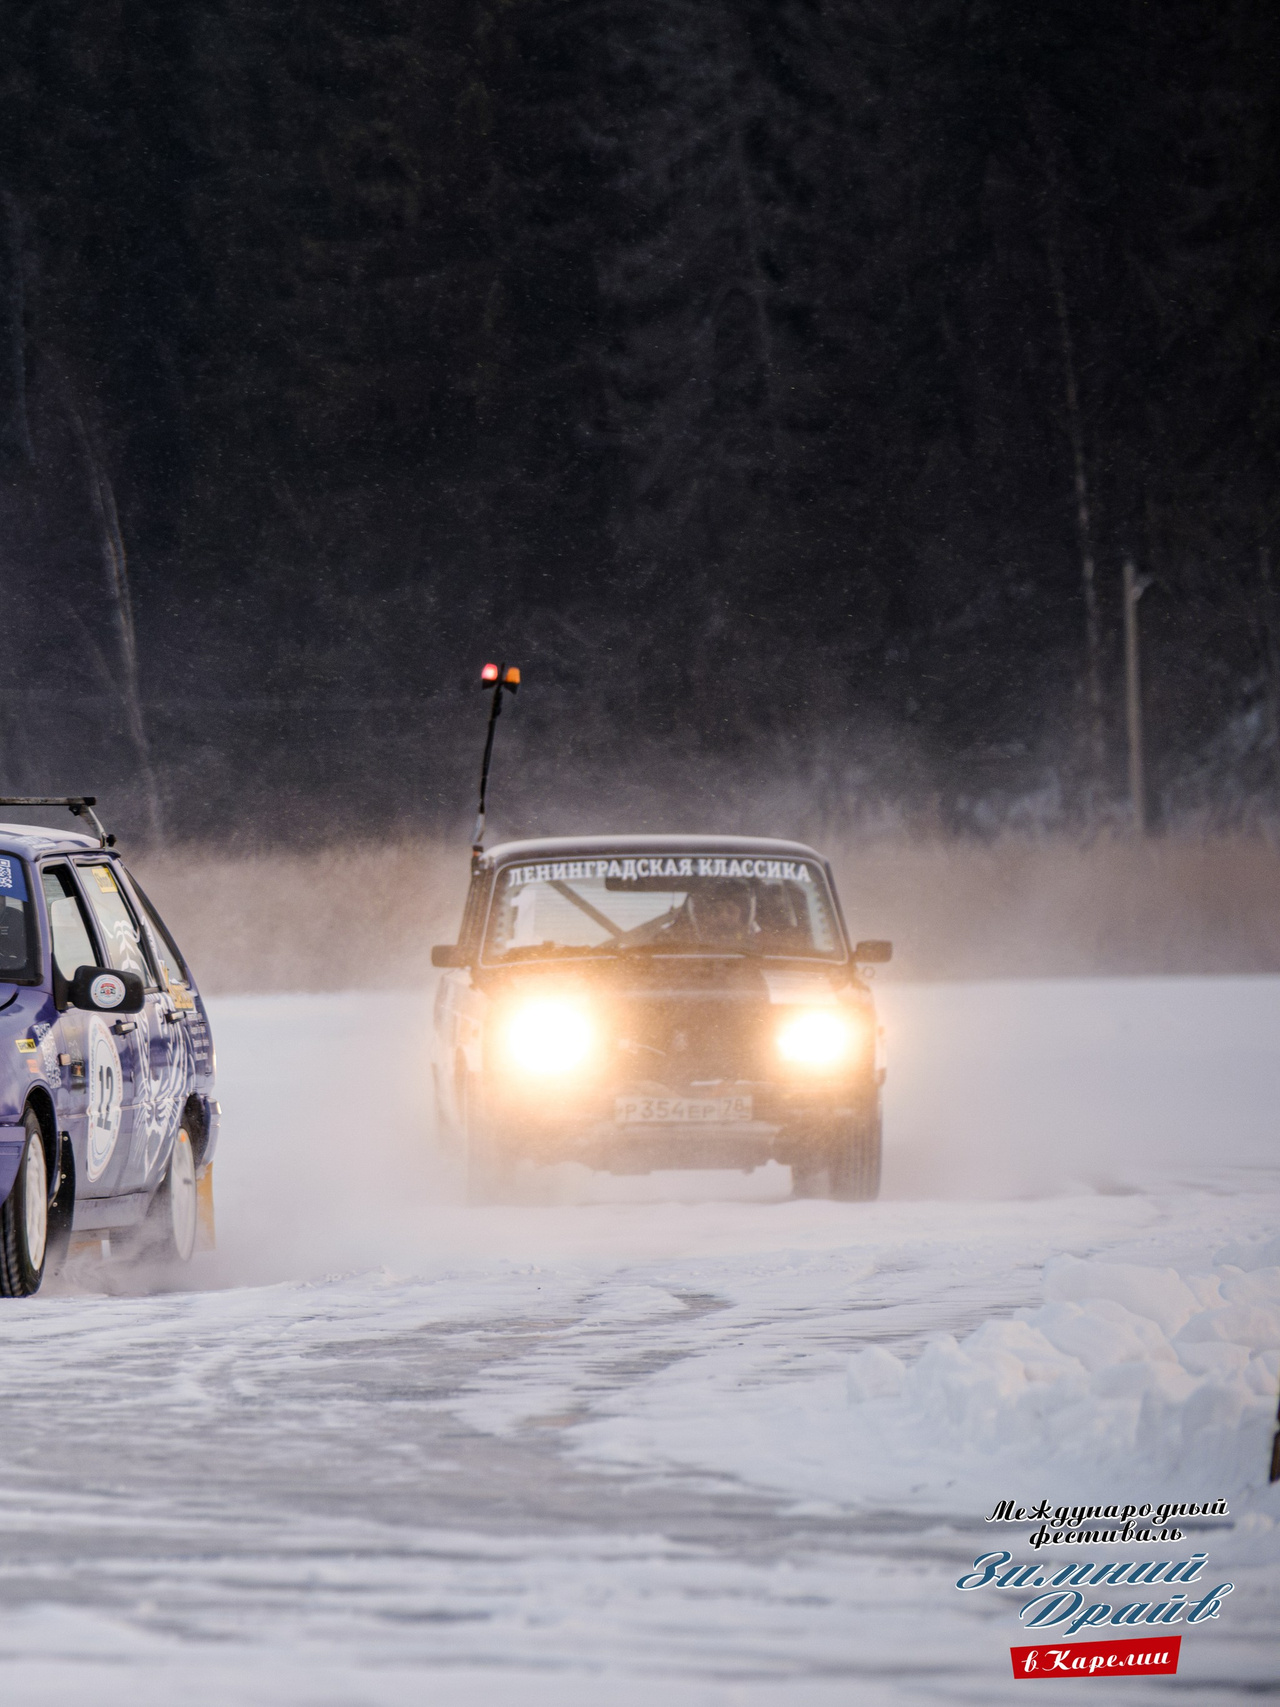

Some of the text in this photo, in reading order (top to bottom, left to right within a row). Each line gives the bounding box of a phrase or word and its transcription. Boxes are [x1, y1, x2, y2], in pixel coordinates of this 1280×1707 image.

[509, 858, 812, 887] ЛЕНИНГРАДСКАЯ КЛАССИКА
[99, 1065, 115, 1131] 12
